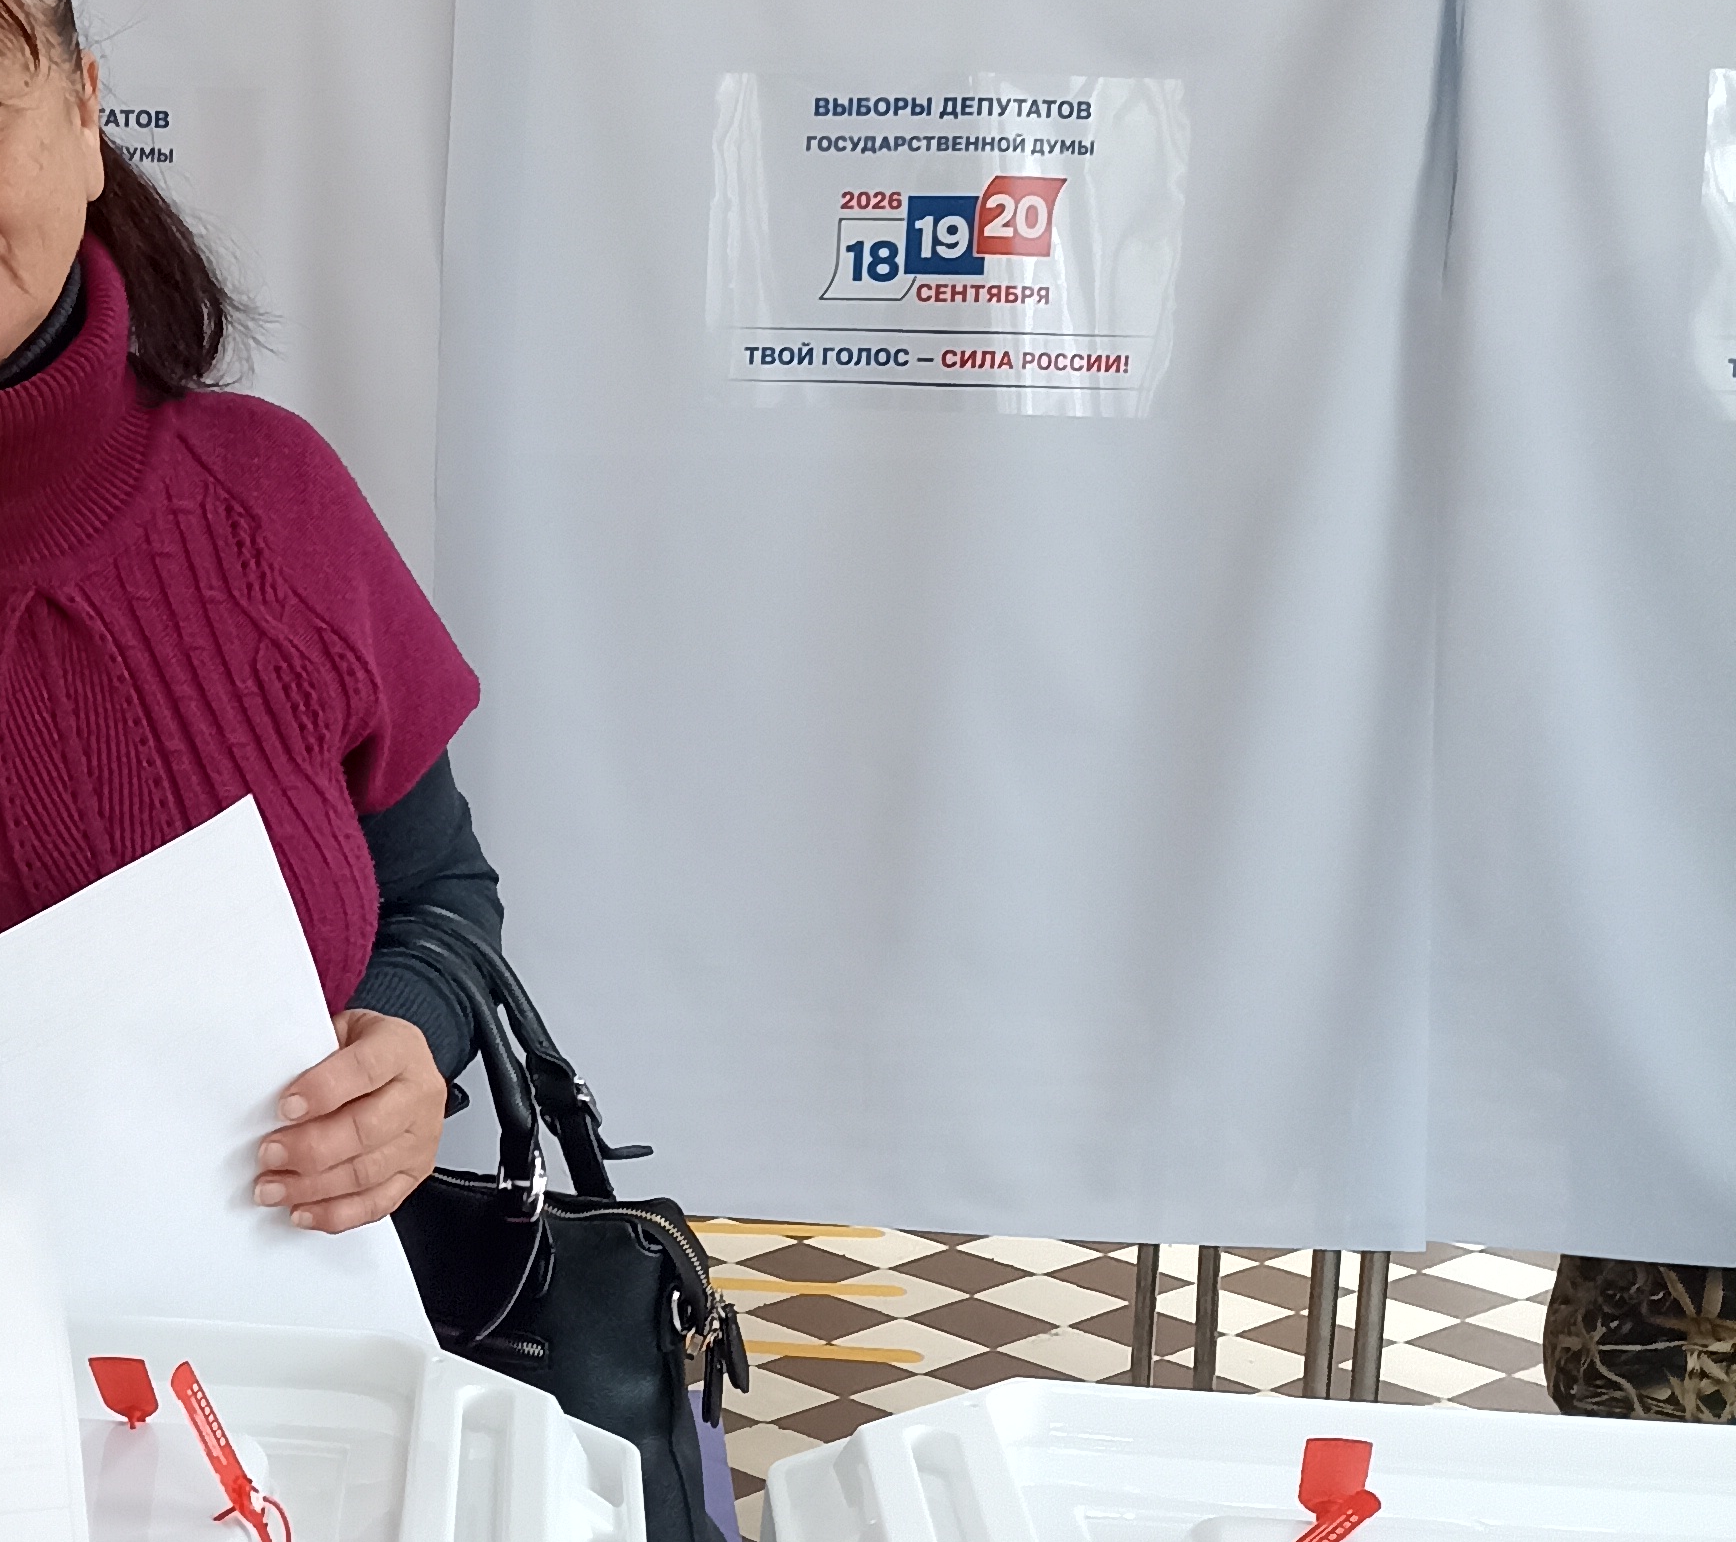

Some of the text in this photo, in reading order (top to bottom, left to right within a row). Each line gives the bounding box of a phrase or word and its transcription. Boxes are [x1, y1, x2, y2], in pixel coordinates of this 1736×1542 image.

[99, 108, 170, 129] АТОВ
[813, 96, 1092, 120] ВЫБОРЫ ДЕПУТАТОВ
[121, 147, 174, 163] УМЫ
[805, 132, 1096, 157] ГОСУДАРСТВЕННОЙ ДУМЫ
[840, 190, 903, 210] 2026
[845, 194, 1048, 283] 18 19 20
[915, 283, 1051, 306] СЕНТЯБРЯ
[744, 341, 815, 367] ТВОЙ
[821, 346, 910, 368] ГОЛОС
[940, 349, 1014, 370] СИЛА
[1021, 351, 1130, 374] РОССИИ!
